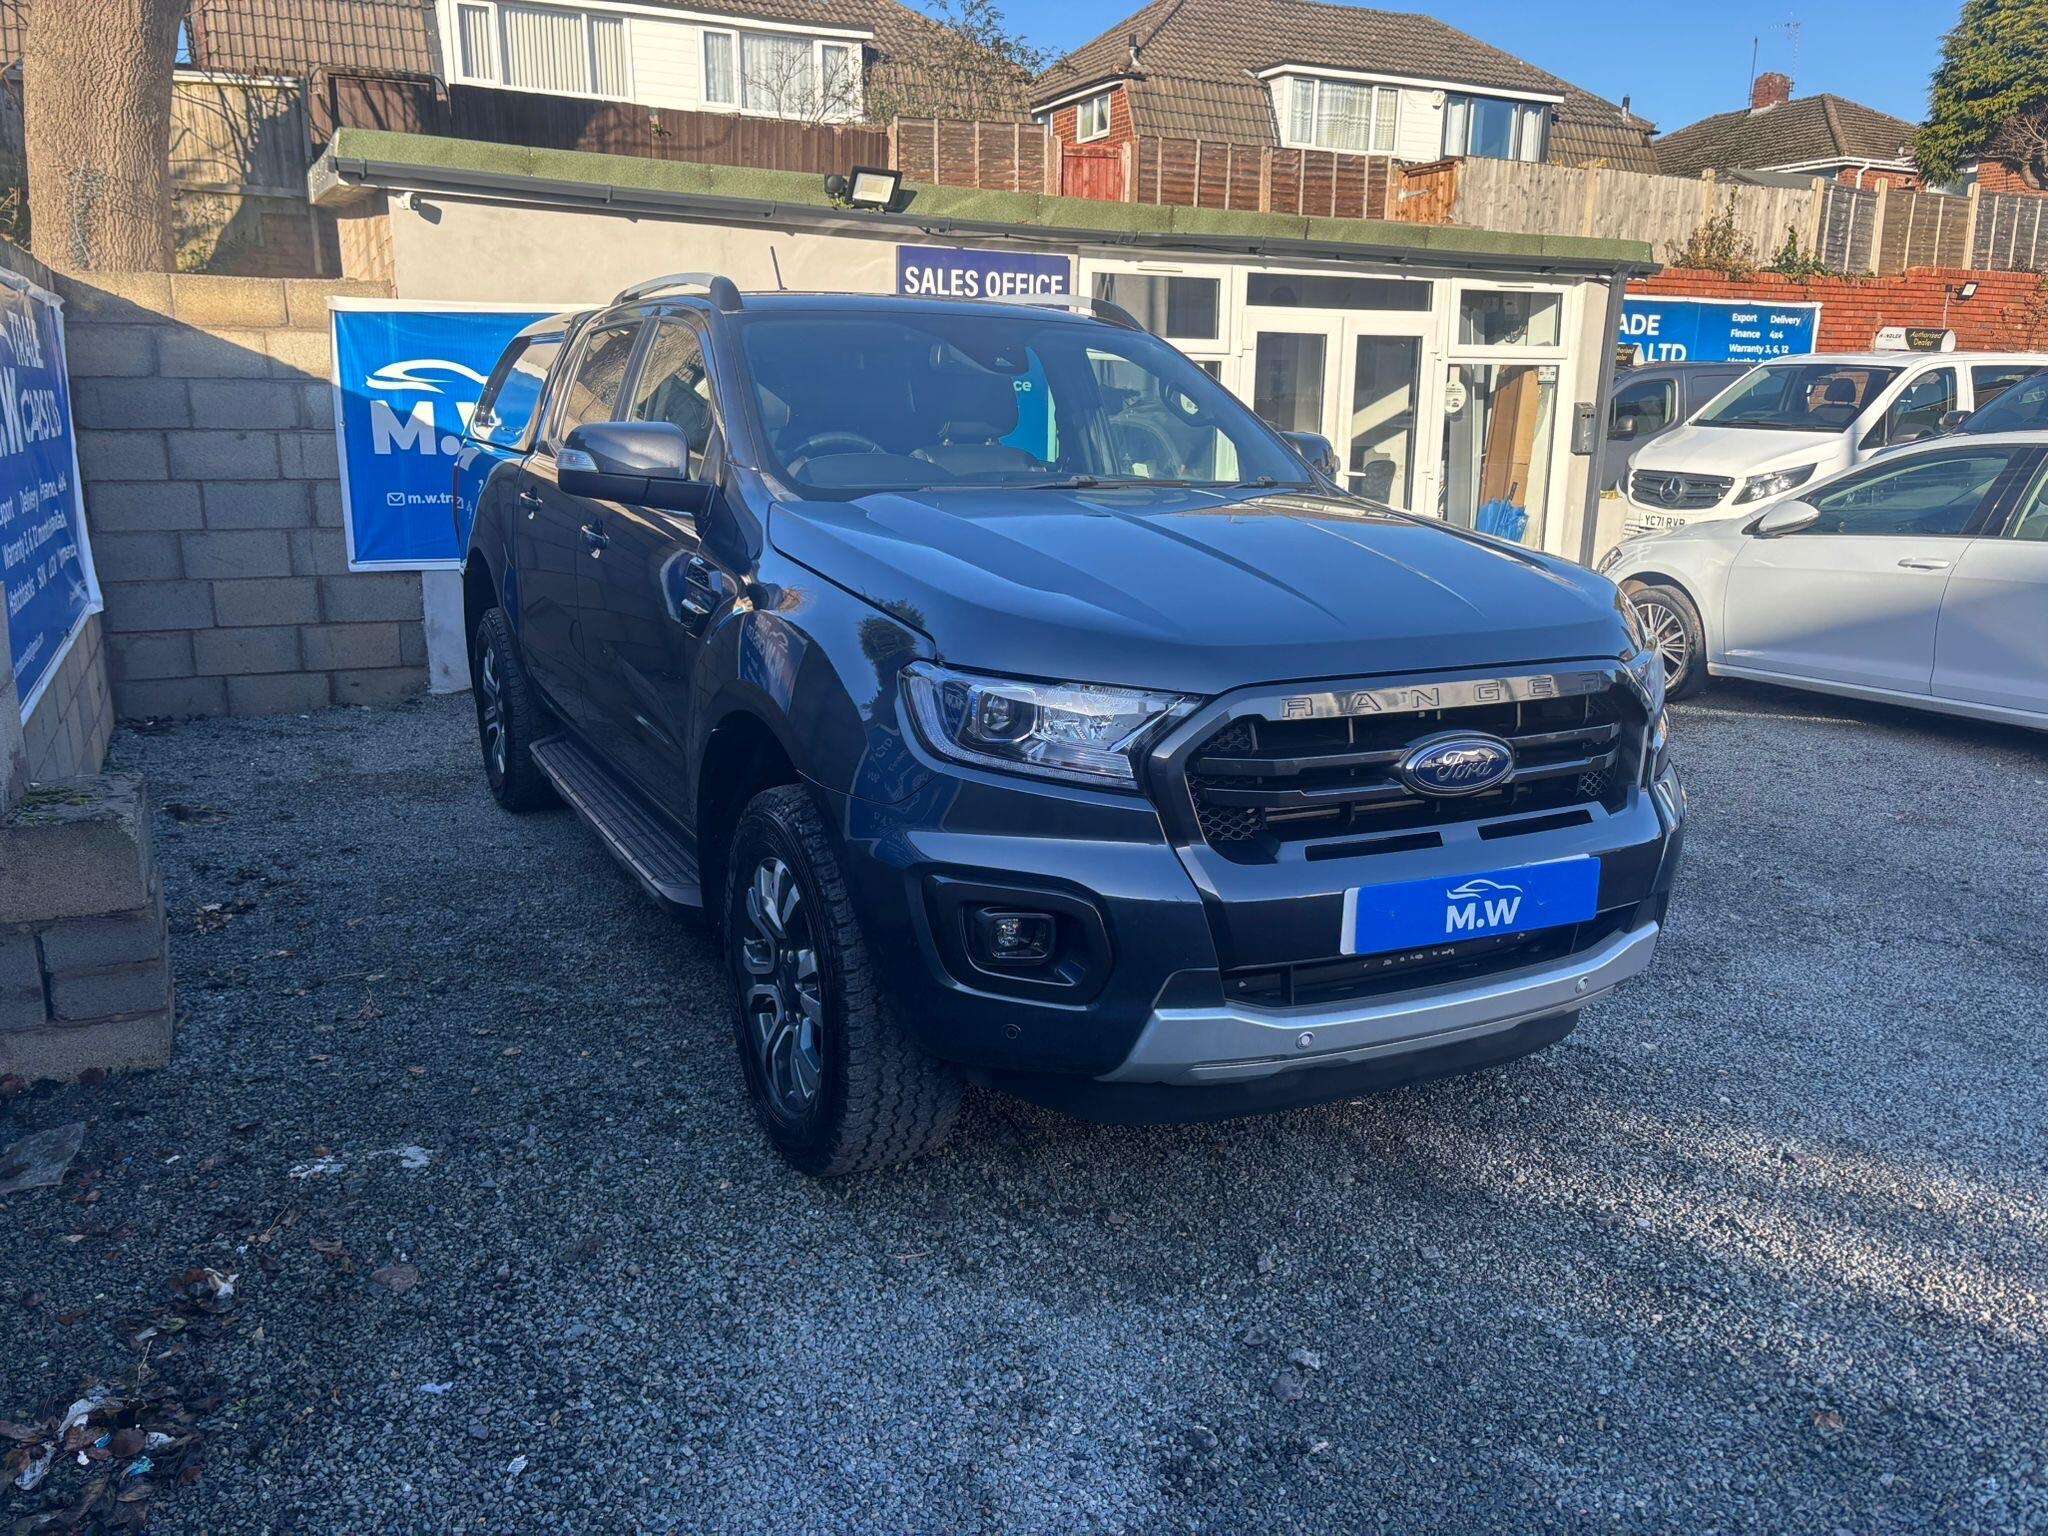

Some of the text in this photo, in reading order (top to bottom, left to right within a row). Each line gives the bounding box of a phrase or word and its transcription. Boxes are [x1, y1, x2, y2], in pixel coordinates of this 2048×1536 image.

[904, 266, 1063, 297] SALES OFFICE
[1618, 313, 1661, 336] ADE
[1732, 313, 1801, 326] Export Delivery
[1730, 329, 1761, 339] Finance
[1729, 344, 1764, 355] Warranty
[1781, 345, 1790, 354] 12
[1913, 338, 1934, 347] Dealer
[1647, 342, 1687, 362] LTD
[1013, 380, 1032, 391] ce
[1645, 515, 1665, 527] YC71
[1282, 671, 1601, 718] RANGER
[1428, 748, 1497, 780] Ford
[1446, 896, 1522, 933] M.W
